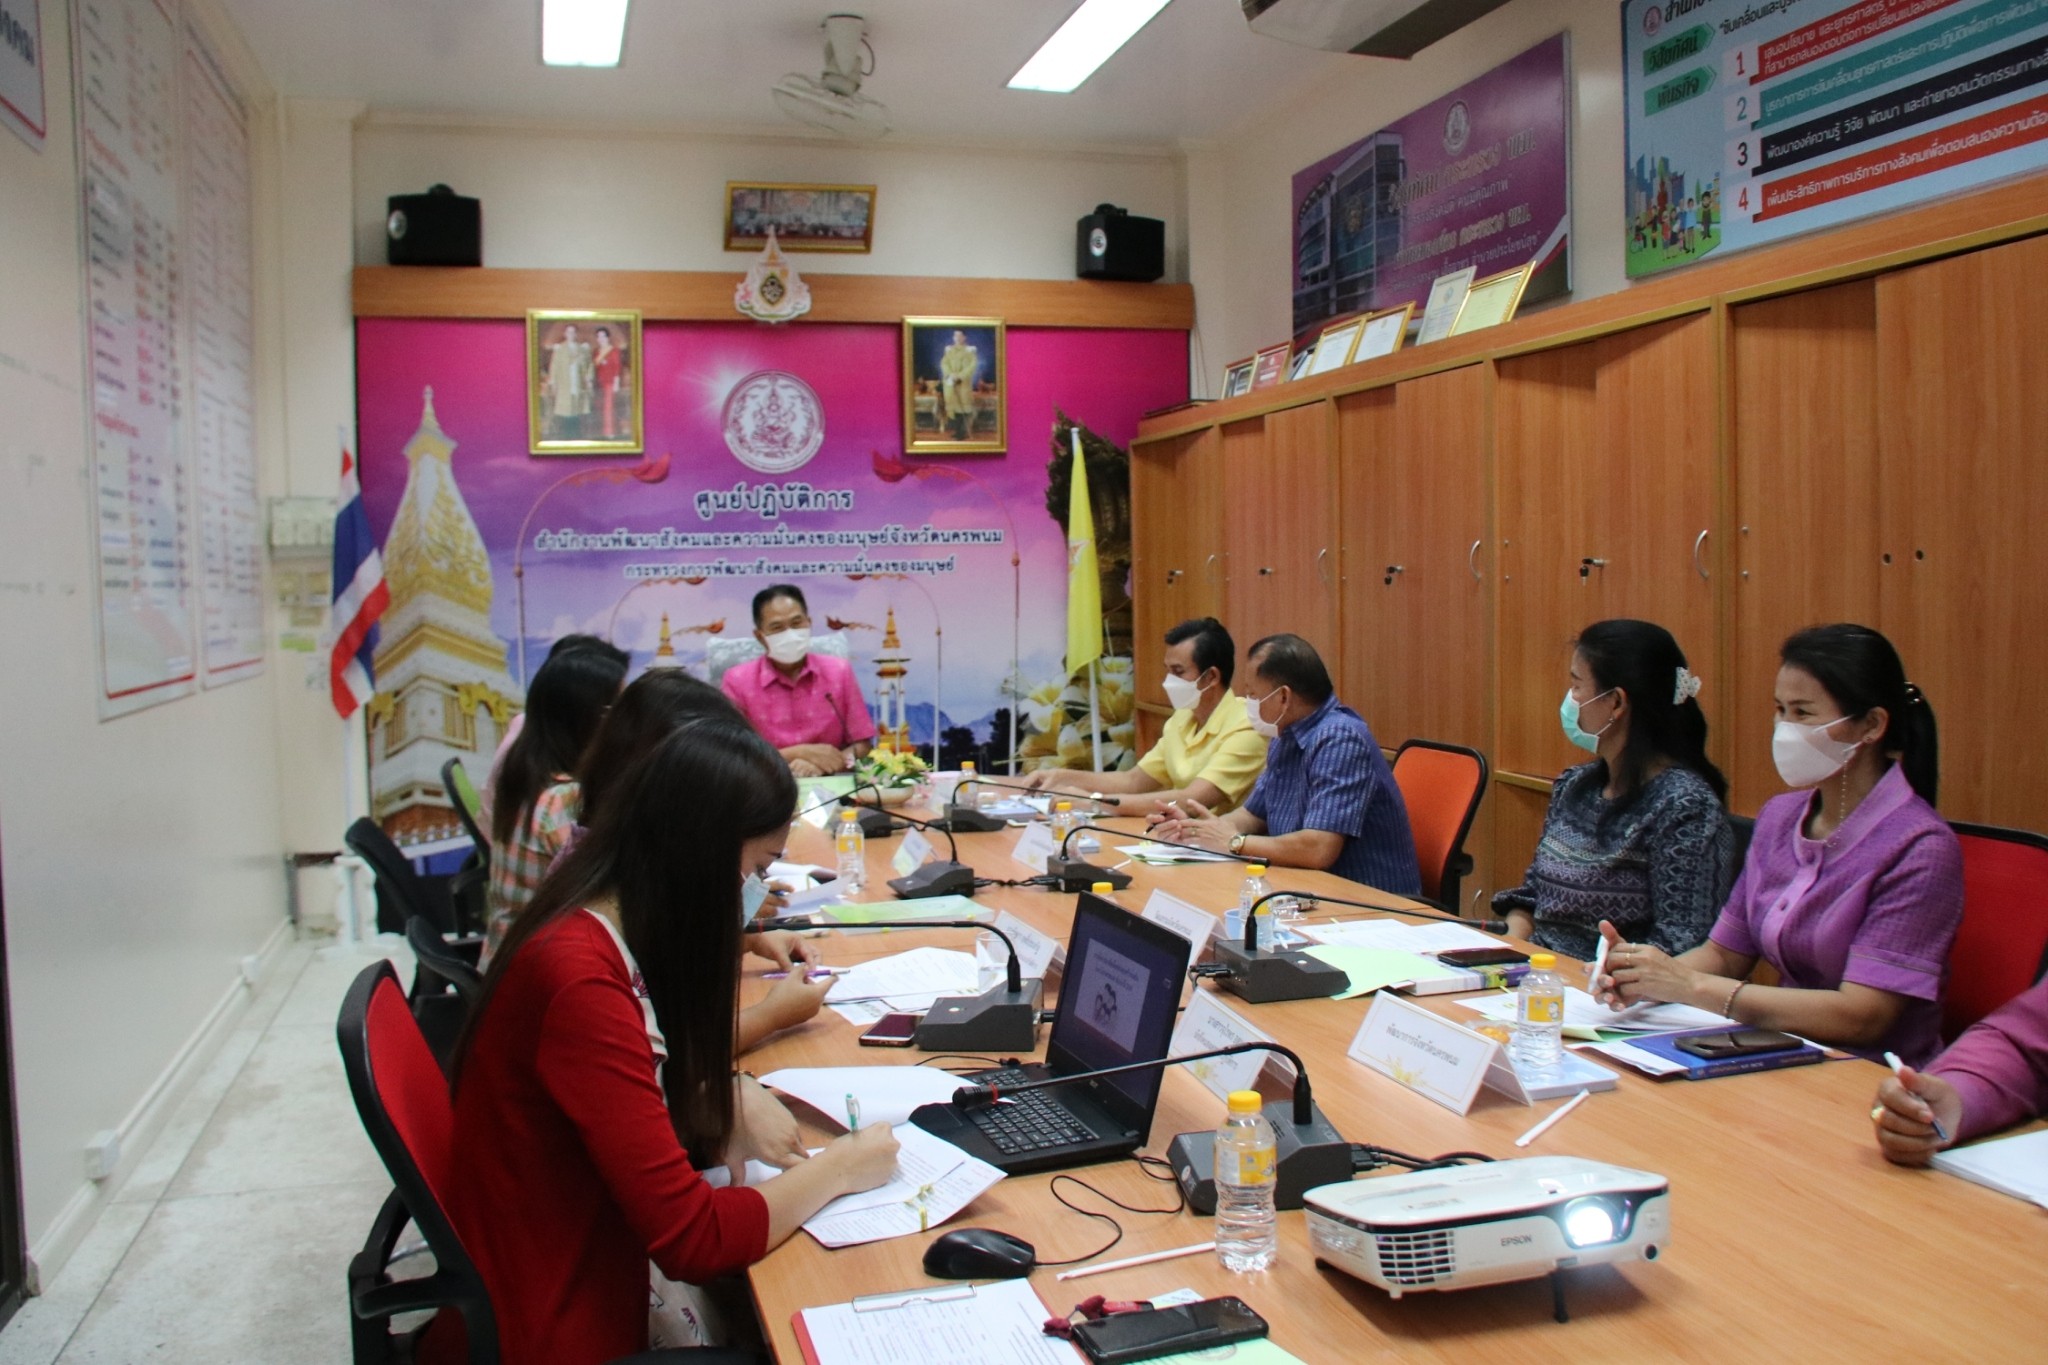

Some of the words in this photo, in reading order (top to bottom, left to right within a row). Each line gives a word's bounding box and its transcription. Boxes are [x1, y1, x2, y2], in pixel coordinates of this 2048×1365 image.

[1764, 31, 1815, 60] เสนอนโยบาย
[1736, 51, 1745, 76] 1
[1736, 97, 1748, 121] 2
[1766, 120, 1841, 160] พัฒนาองค์ความรู้
[1845, 114, 1864, 136] วิจัย
[1867, 105, 1900, 128] พัฒนา
[1737, 142, 1749, 166] 3
[1737, 188, 1749, 211] 4
[696, 483, 853, 518] ศูนย์ปฏิบัติการ
[535, 528, 1003, 550] สำนักงานพัฒนาสังคมและความมั่นคงของมนุษย์จังหวัดนครพนม
[625, 555, 955, 576] กระทรวงการพัฒนาสังคมและความมั่นคงของมนุษย์
[1500, 1234, 1533, 1247] EPSON
